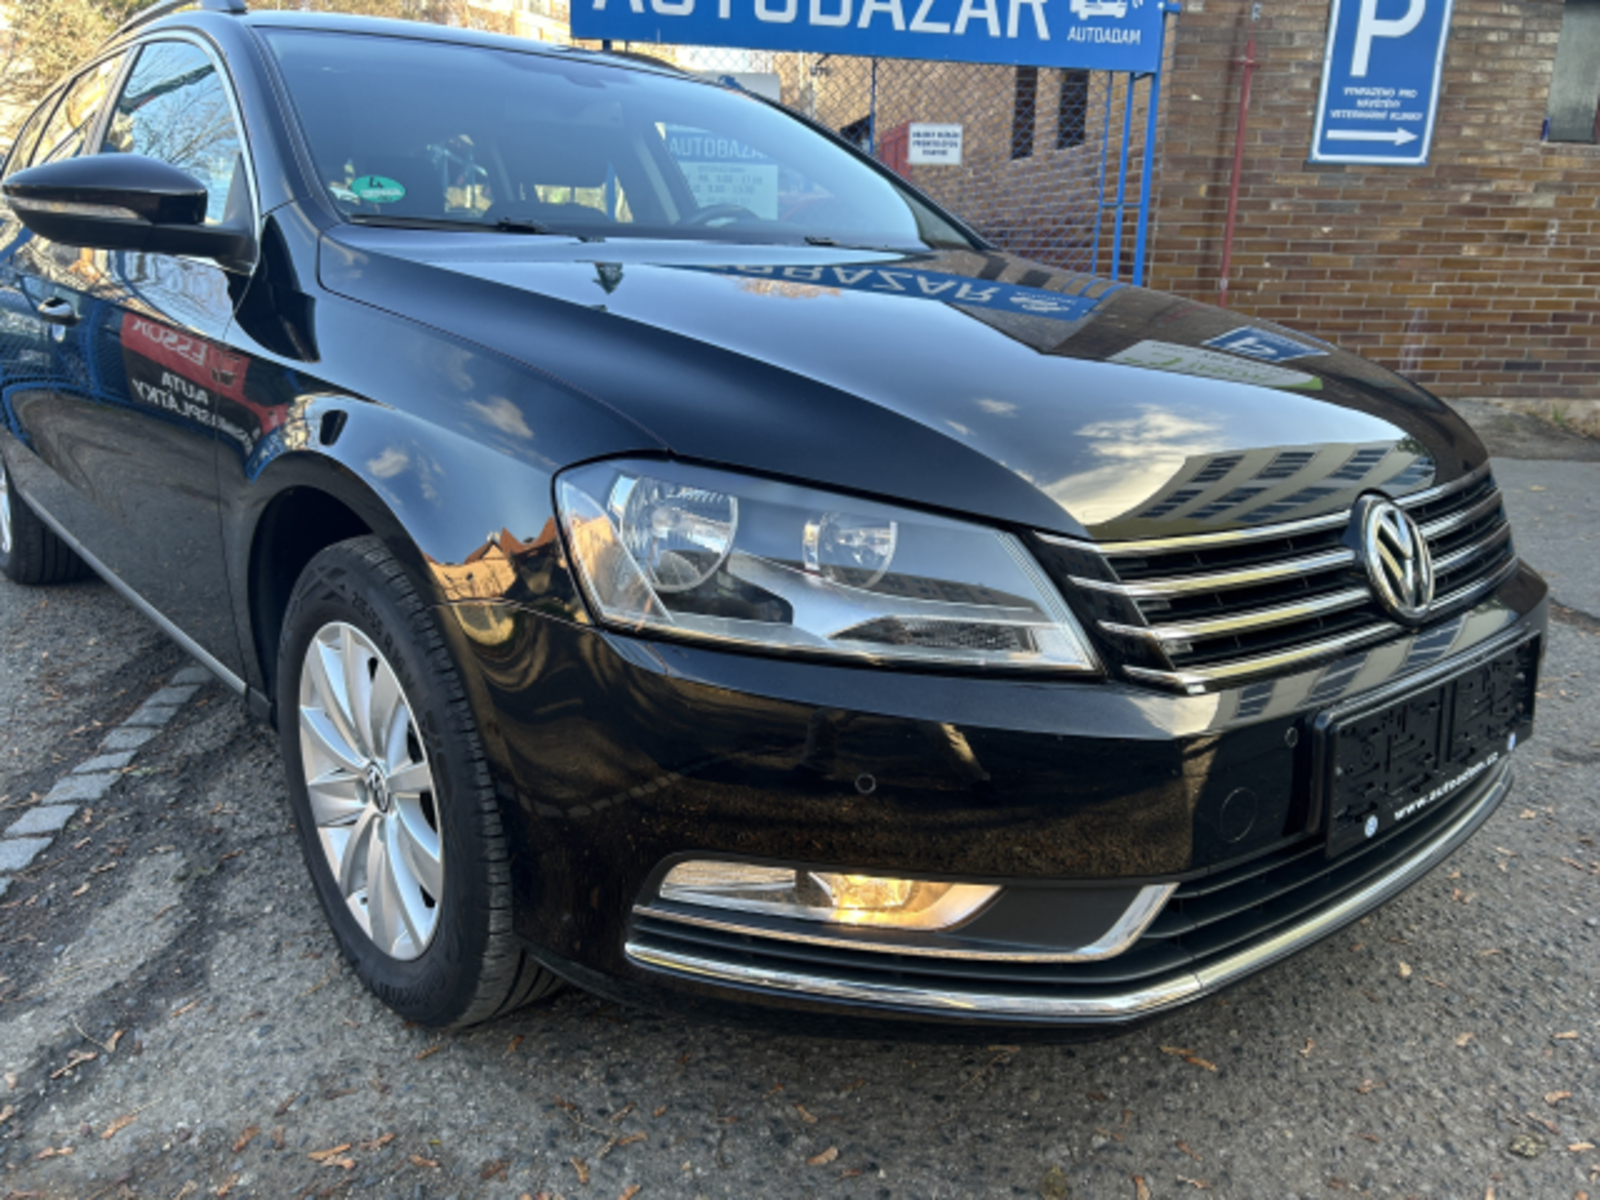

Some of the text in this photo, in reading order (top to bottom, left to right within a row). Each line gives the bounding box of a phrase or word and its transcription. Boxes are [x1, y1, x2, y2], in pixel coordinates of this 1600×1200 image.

[1067, 25, 1141, 45] AUTOADAM
[1350, 0, 1427, 77] P
[669, 136, 769, 159] AUTOBAZA
